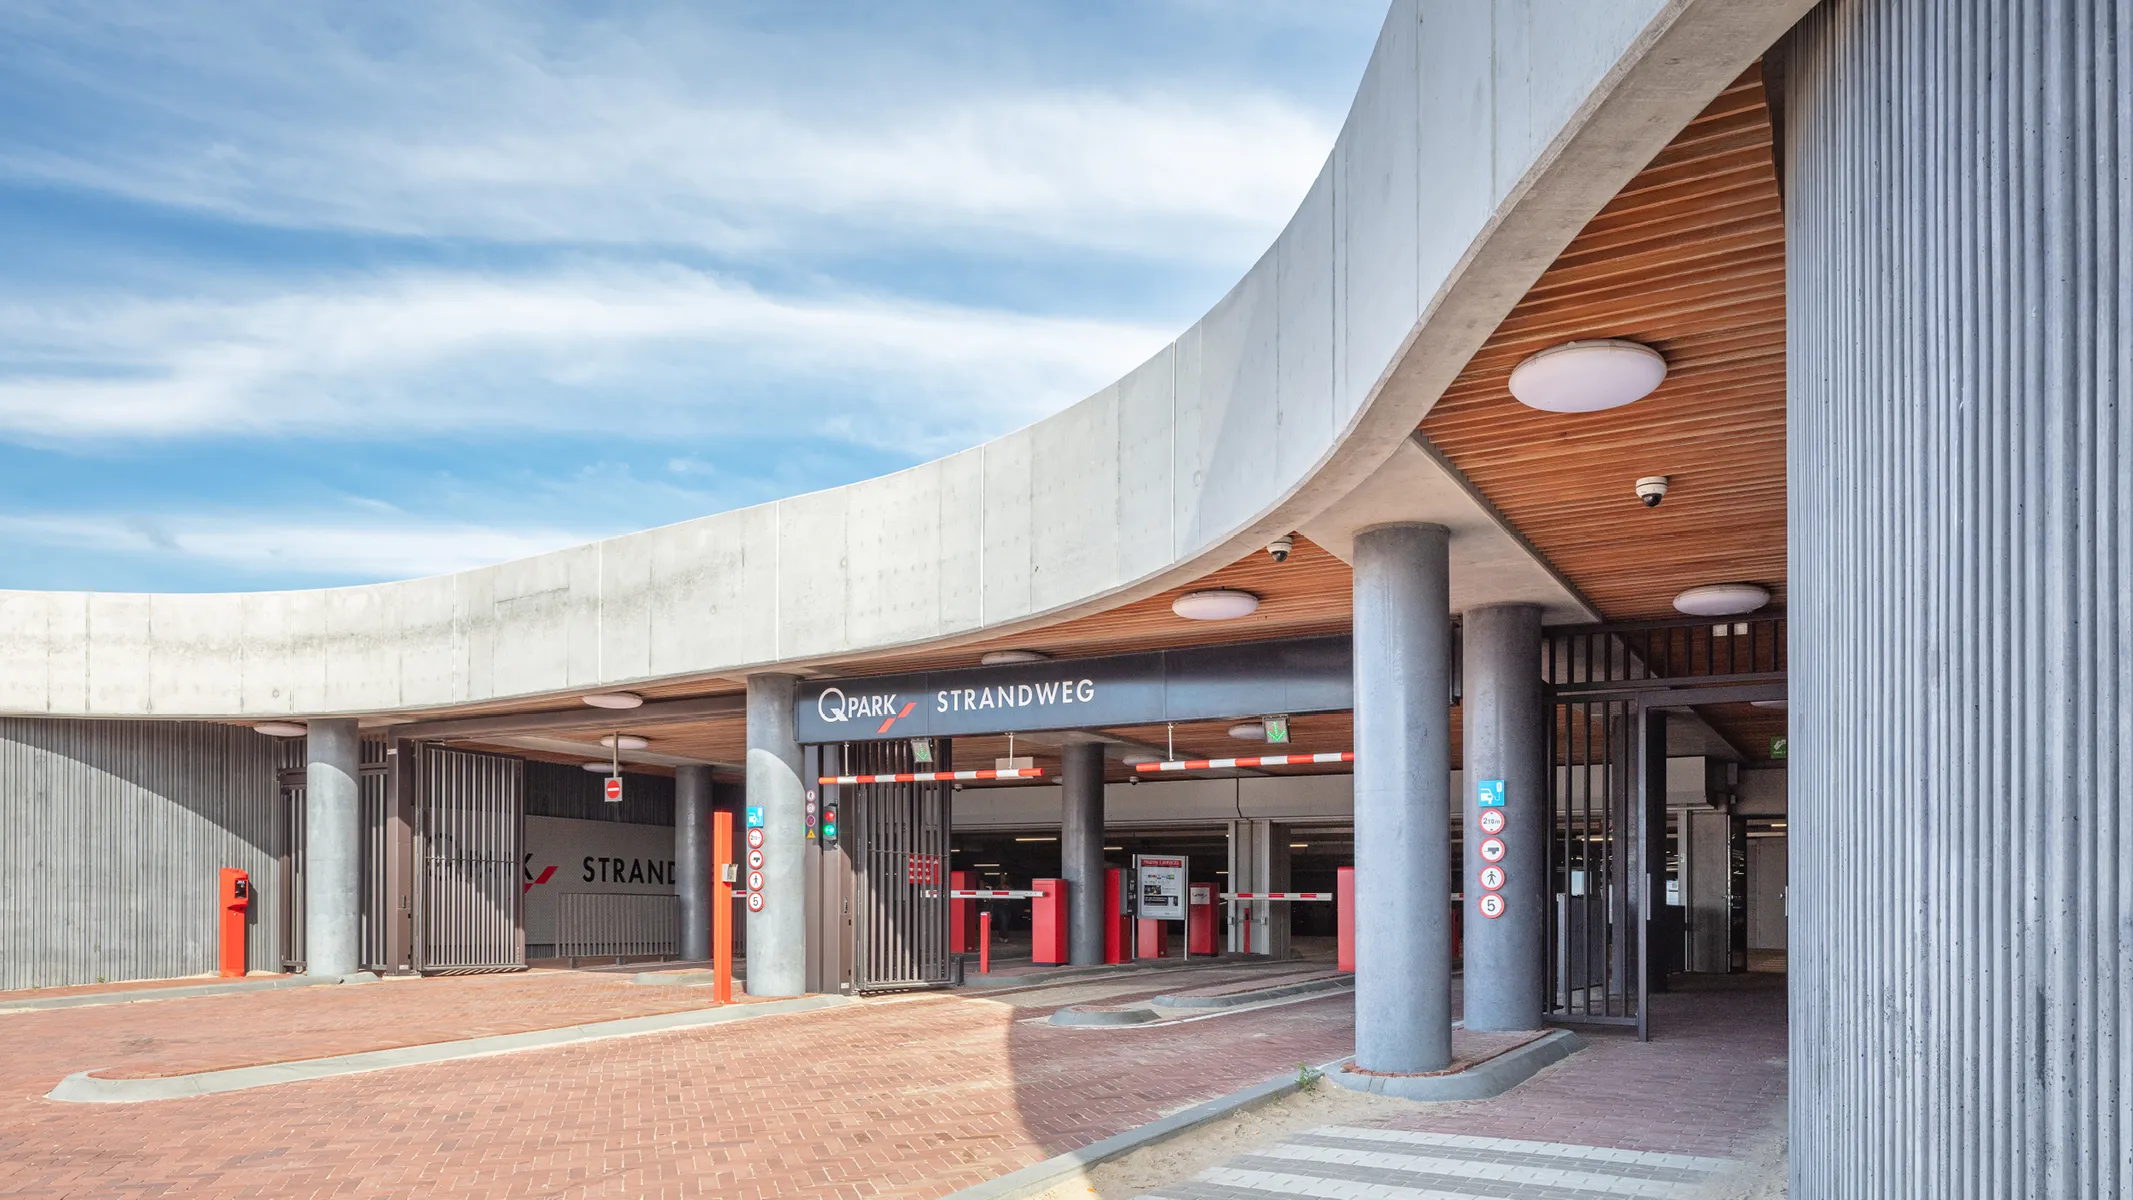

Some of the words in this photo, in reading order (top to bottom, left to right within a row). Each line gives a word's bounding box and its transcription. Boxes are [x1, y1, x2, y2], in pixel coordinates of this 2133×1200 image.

[818, 687, 897, 722] QPARK
[937, 679, 1095, 713] STRANDWEG
[752, 896, 759, 907] 5
[1487, 899, 1496, 912] 5
